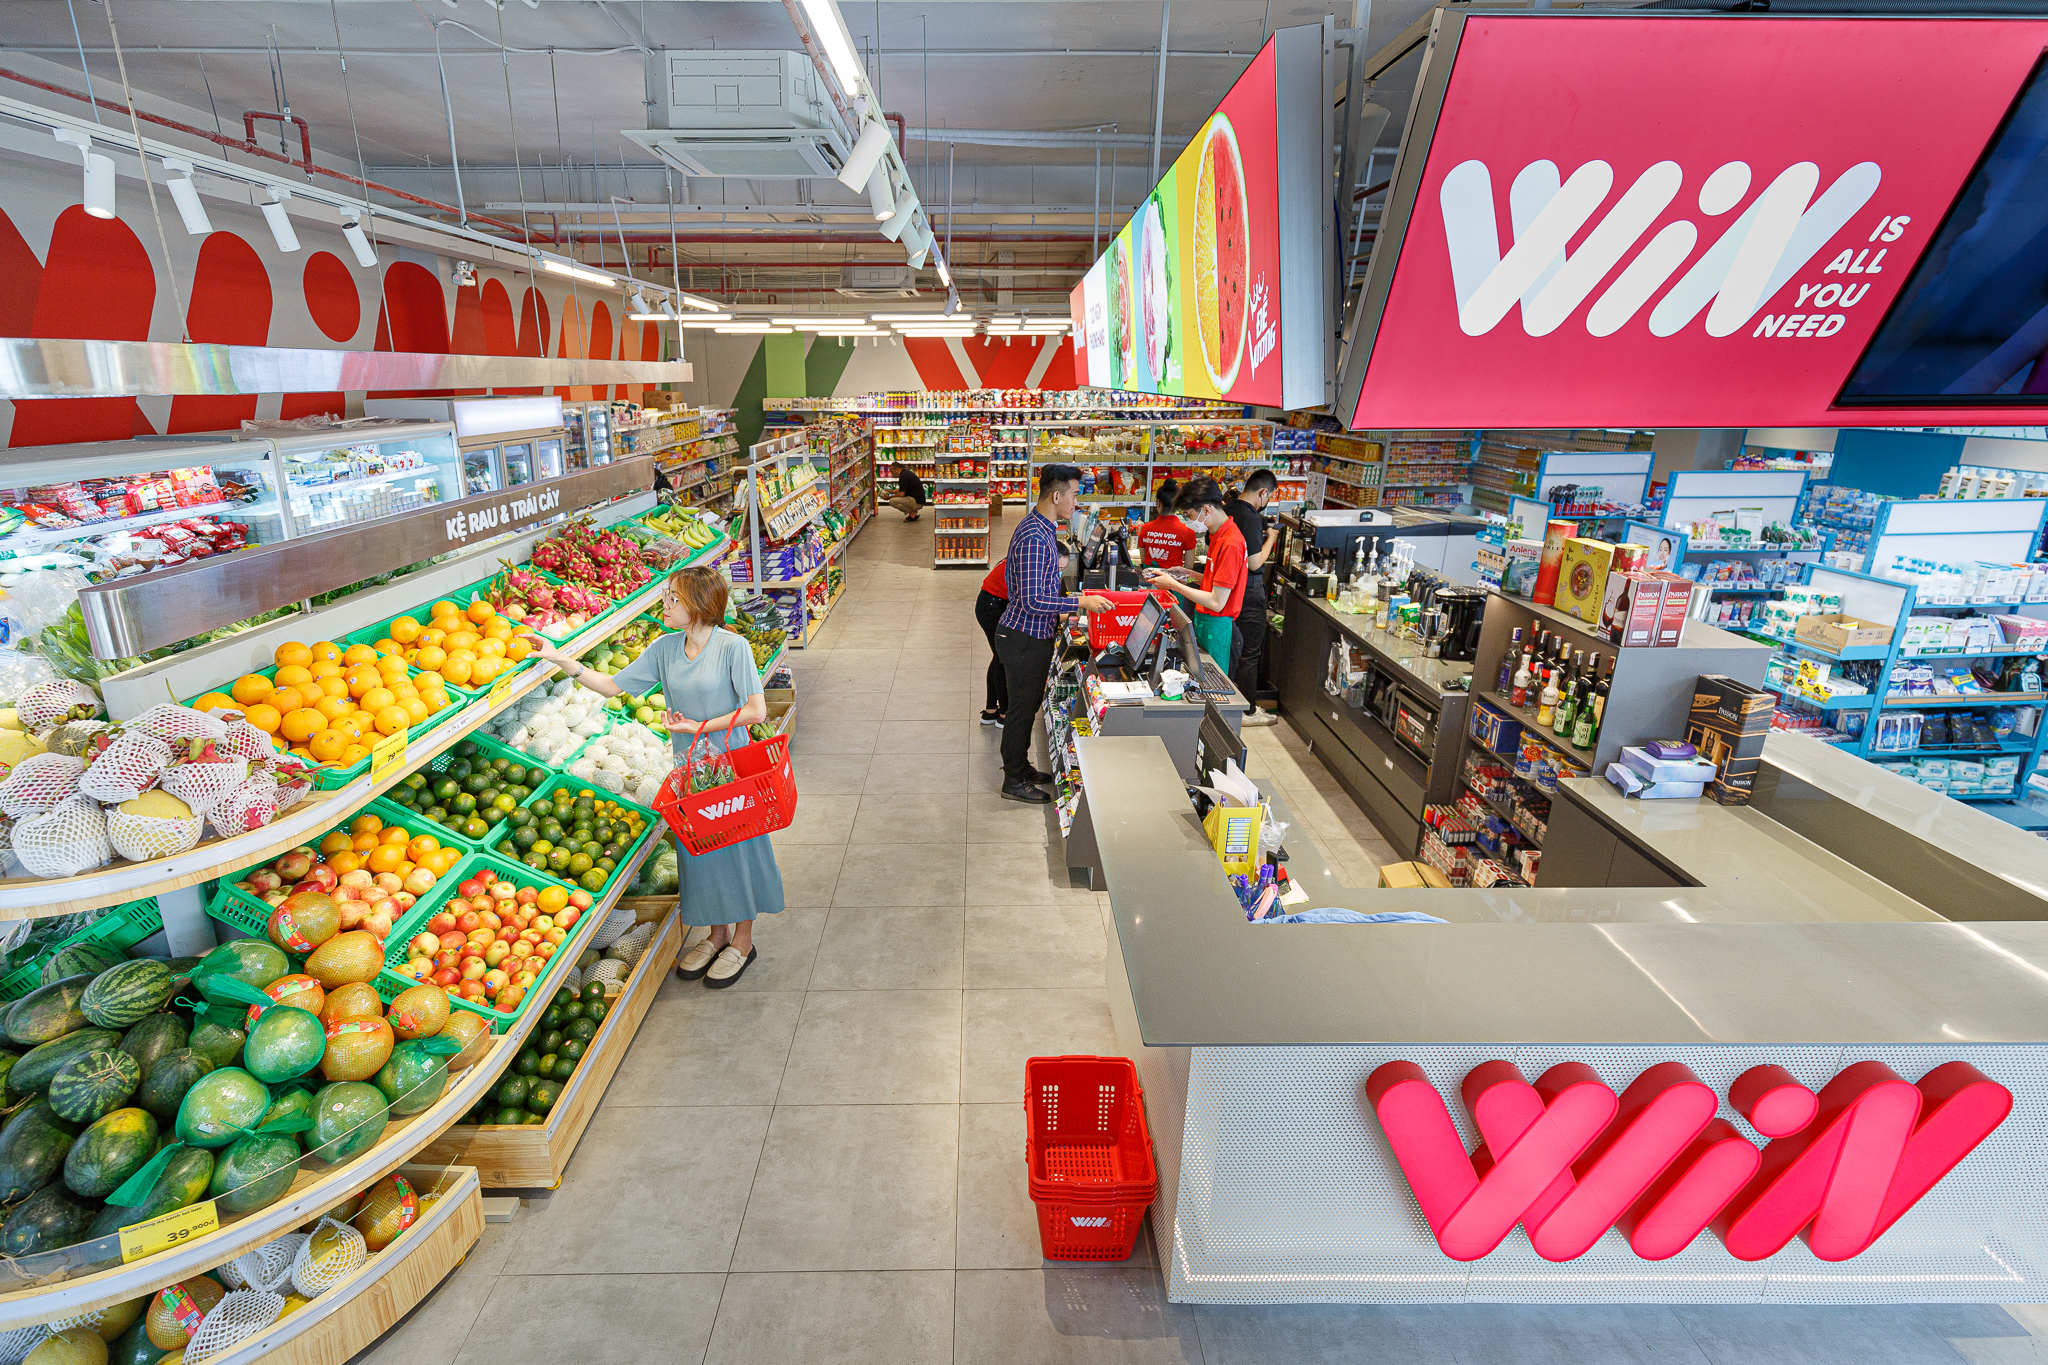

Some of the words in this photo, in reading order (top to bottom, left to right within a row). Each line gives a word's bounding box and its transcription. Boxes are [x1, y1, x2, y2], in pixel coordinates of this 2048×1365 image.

[1868, 215, 1911, 242] IS
[1823, 248, 1888, 274] ALL
[1794, 283, 1871, 308] YOU
[1752, 314, 1846, 338] NEED
[445, 511, 468, 542] KỆ
[468, 507, 498, 534] RAU
[500, 504, 510, 524] &
[510, 492, 538, 520] TRÁI
[538, 487, 560, 512] CÂY
[1718, 706, 1739, 721] PASSION
